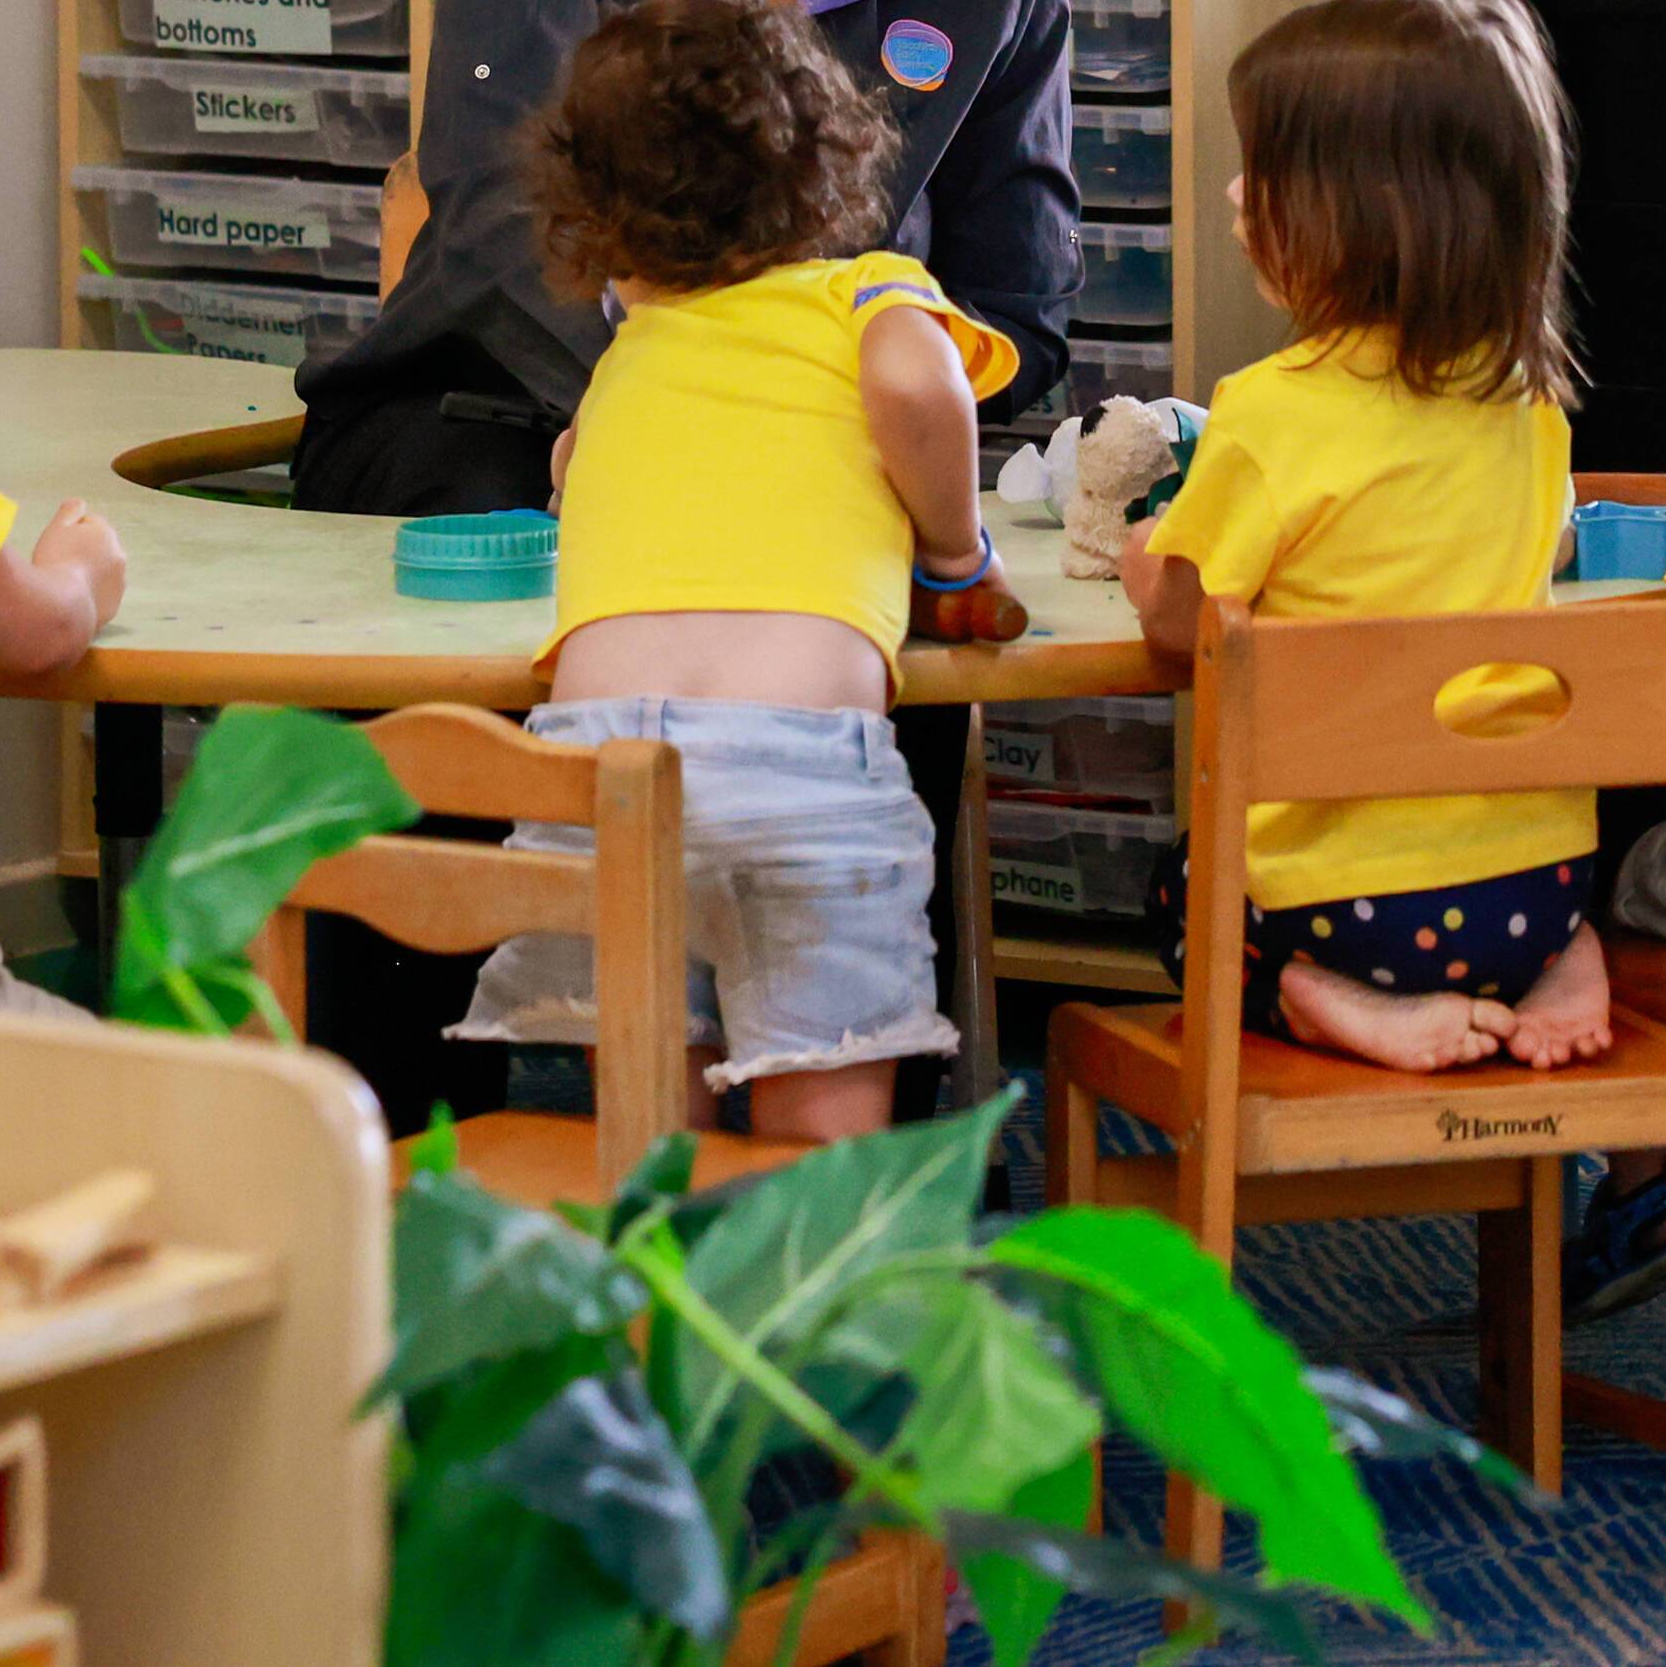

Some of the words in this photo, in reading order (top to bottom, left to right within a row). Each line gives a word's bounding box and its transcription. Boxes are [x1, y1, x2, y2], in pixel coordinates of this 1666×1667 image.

[155, 15, 257, 48] bottoms
[196, 91, 296, 124] Stickers
[158, 207, 218, 238] Hard
[225, 219, 307, 247] paper
[984, 736, 1041, 773] Clay
[991, 867, 1075, 903] phane
